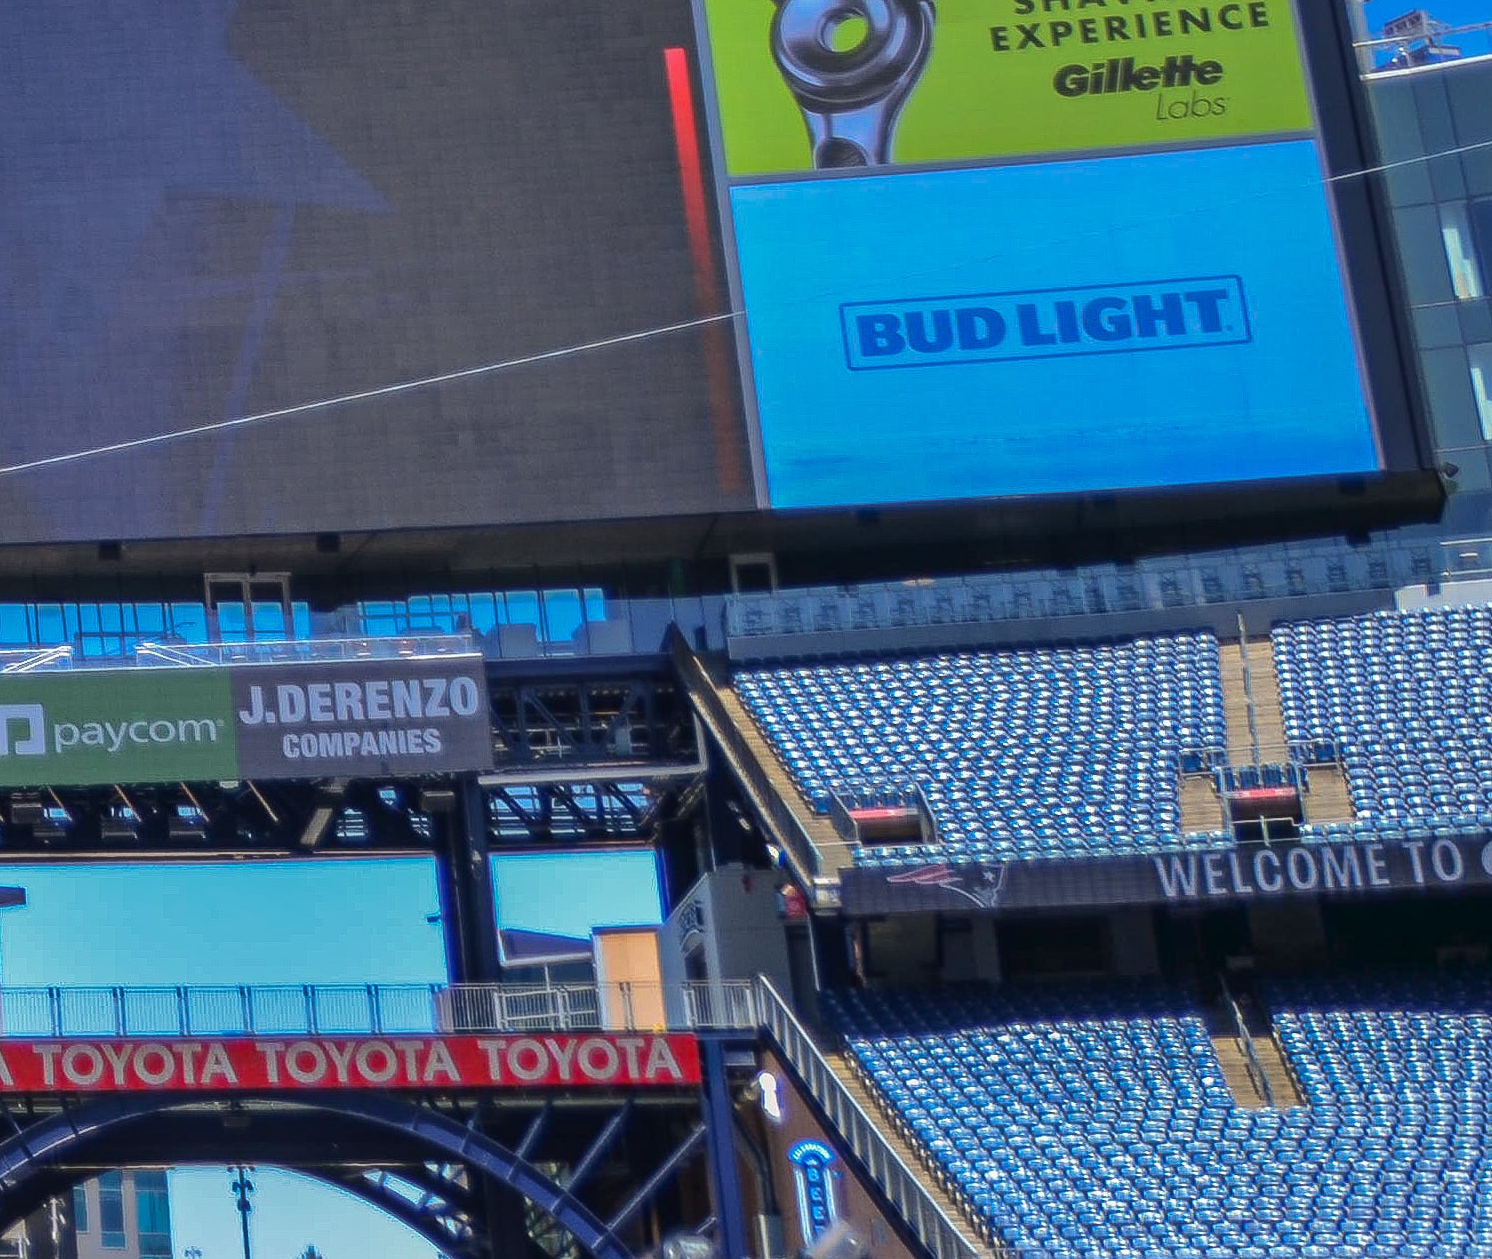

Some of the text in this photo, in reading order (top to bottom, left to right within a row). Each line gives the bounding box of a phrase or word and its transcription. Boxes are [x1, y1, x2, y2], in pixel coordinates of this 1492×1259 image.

[989, 1, 1269, 52] EXPERIENCE
[1053, 54, 1225, 98] Gillette
[1155, 89, 1227, 120] Labs
[856, 306, 1007, 357] BUD
[238, 676, 479, 725] J.DERENZO
[53, 716, 215, 753] paycom
[282, 727, 442, 759] COMPANIES
[1152, 844, 1391, 897] WELCOME
[1403, 840, 1463, 883] TO
[33, 1042, 239, 1086] TOYOTA
[256, 1040, 461, 1084] TOYOTA
[477, 1038, 682, 1081] TOYOTA
